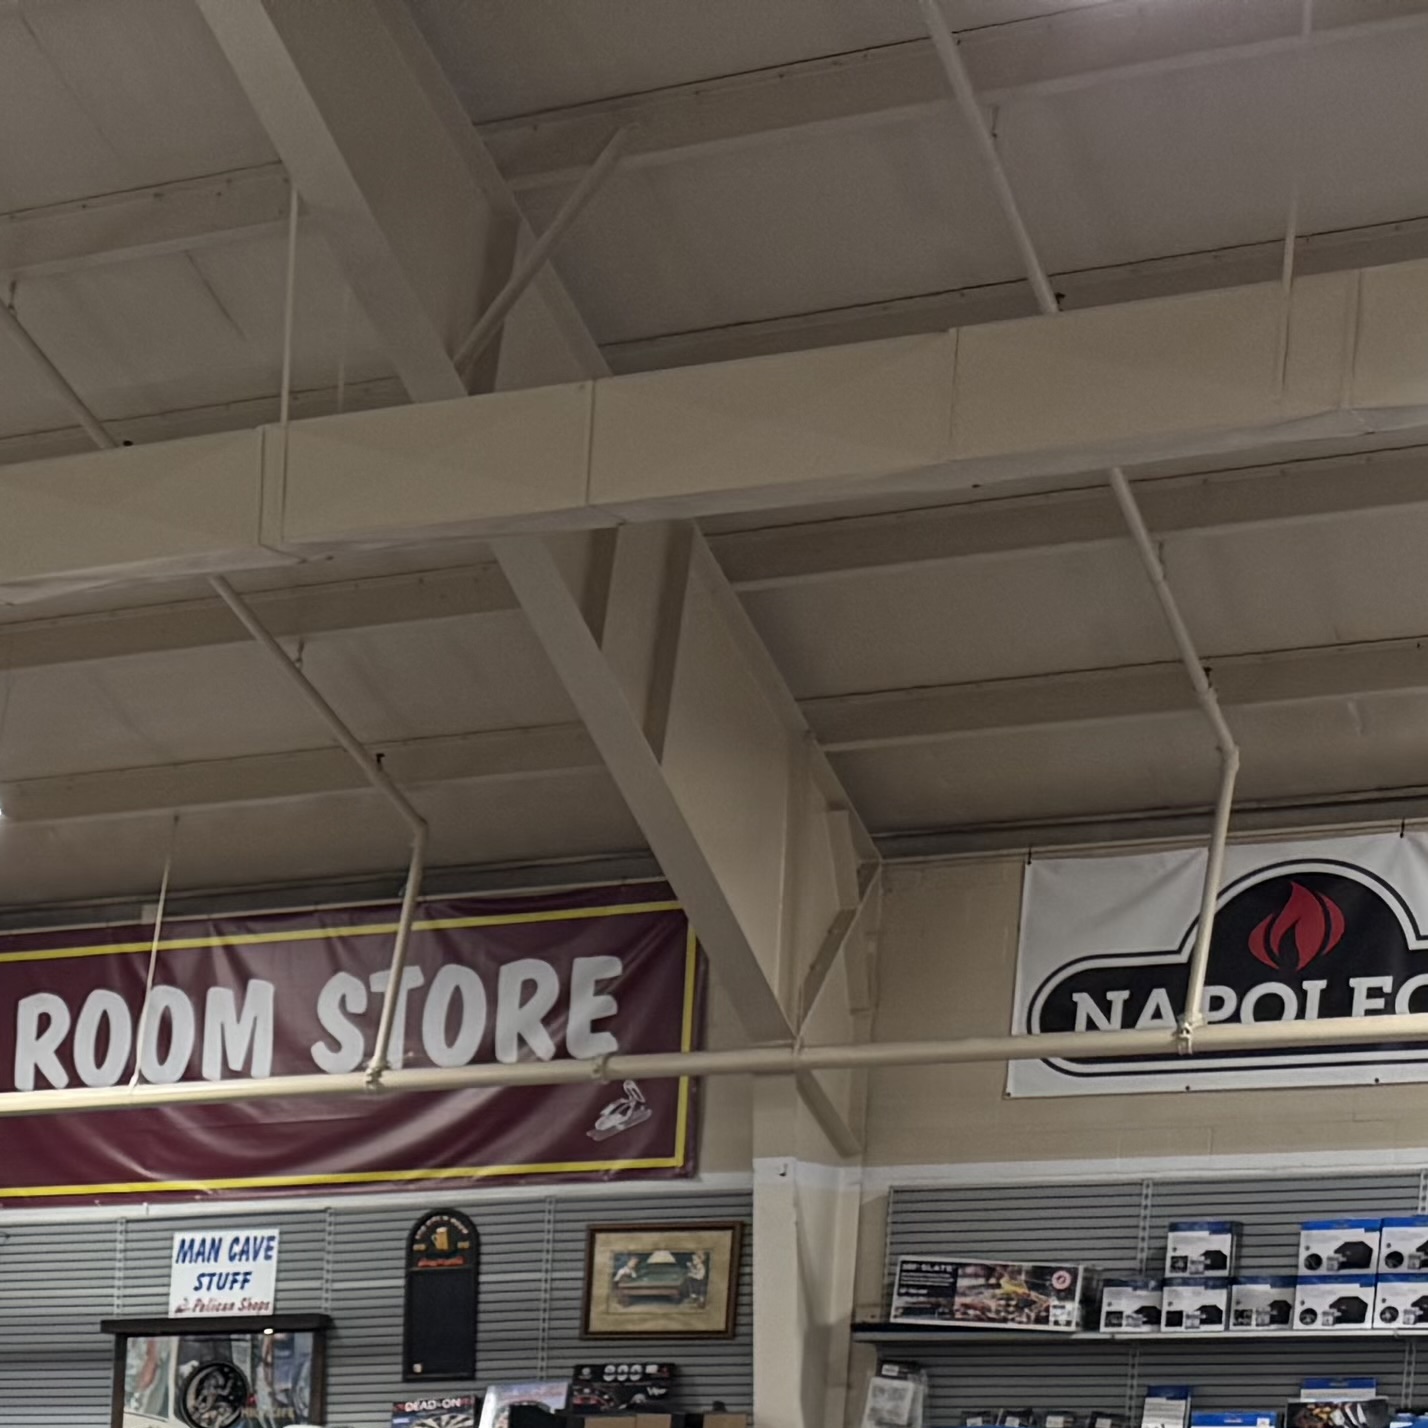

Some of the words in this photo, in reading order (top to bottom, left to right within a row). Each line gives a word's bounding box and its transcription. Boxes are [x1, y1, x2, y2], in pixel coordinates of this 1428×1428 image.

[12, 978, 277, 1092] ROOM
[310, 954, 624, 1074] STORE
[175, 1236, 223, 1264] MAN
[227, 1234, 277, 1262] CAVE
[192, 1270, 253, 1292] STUFF
[191, 1298, 236, 1313] Pelican
[237, 1297, 271, 1314] Shops
